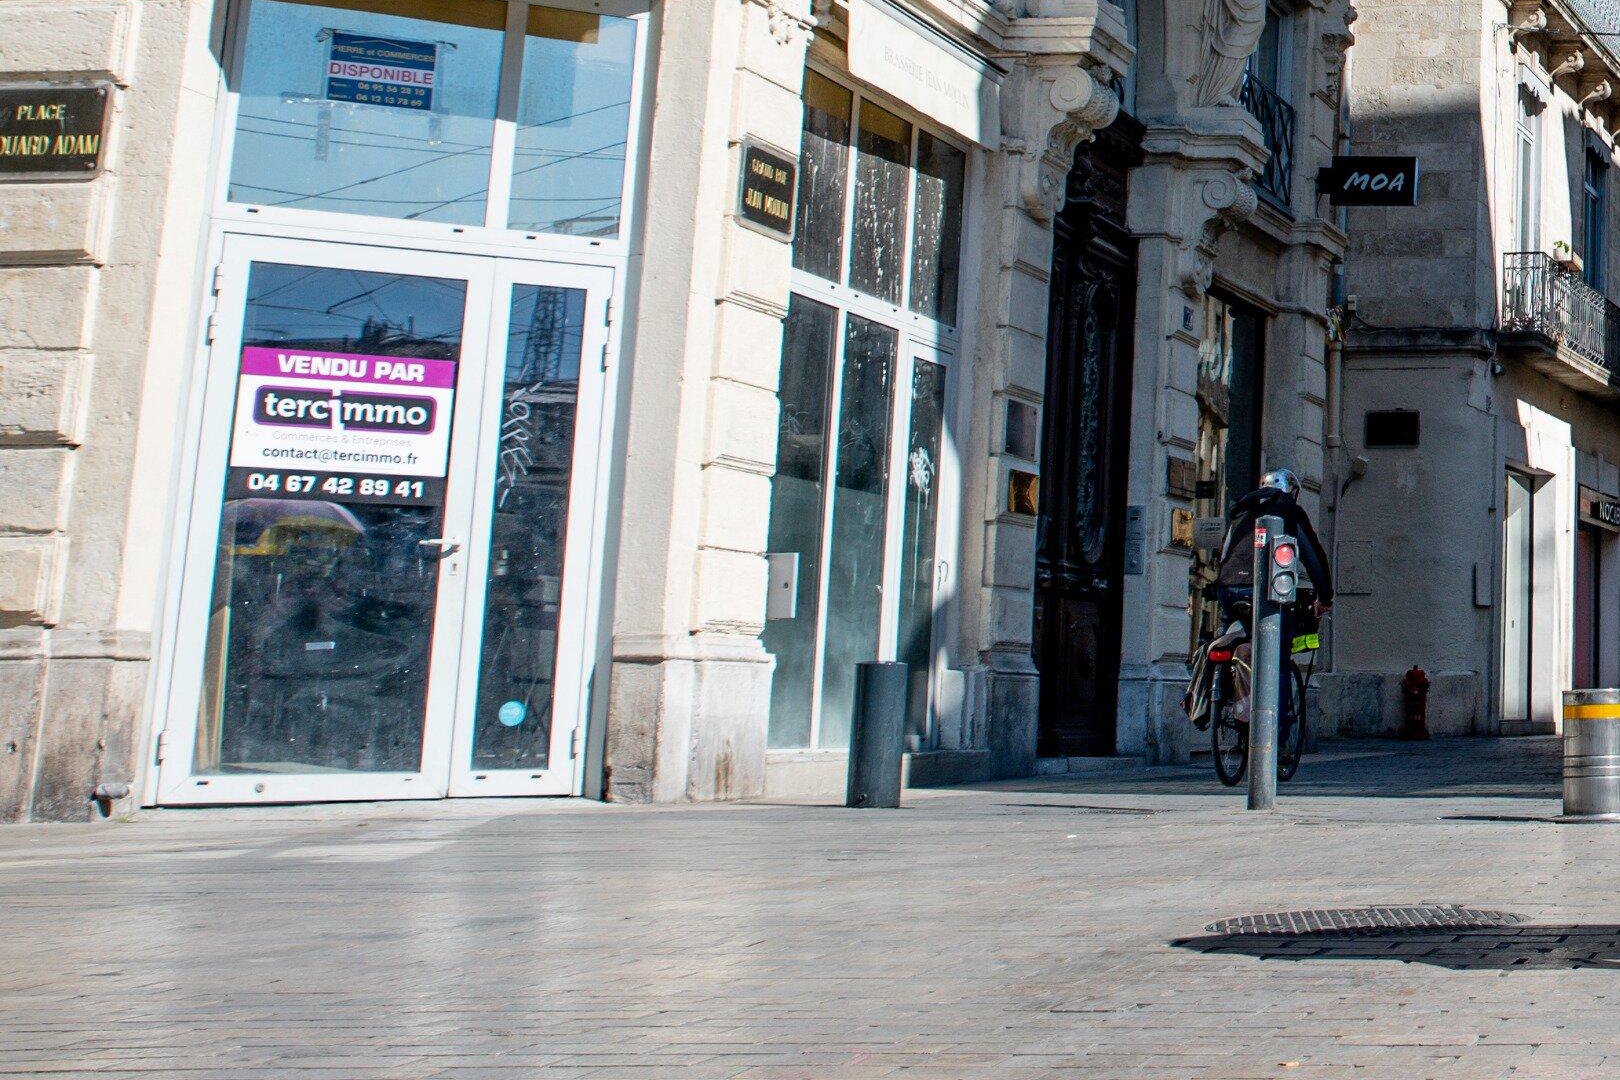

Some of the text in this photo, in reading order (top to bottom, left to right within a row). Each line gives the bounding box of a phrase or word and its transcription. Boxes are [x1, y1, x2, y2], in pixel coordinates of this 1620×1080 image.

[329, 62, 434, 85] DISPONIBLE
[16, 104, 67, 120] PLACE
[53, 134, 99, 155] ADAM
[1343, 171, 1405, 191] MOA
[278, 354, 425, 382] VENDU PAR
[264, 390, 428, 429] tercimmo
[272, 430, 338, 444] Commerces
[352, 436, 413, 448] Entreprises
[262, 446, 418, 465] contact@tercimmo.fr
[247, 473, 425, 498] 04 67 42 89 41
